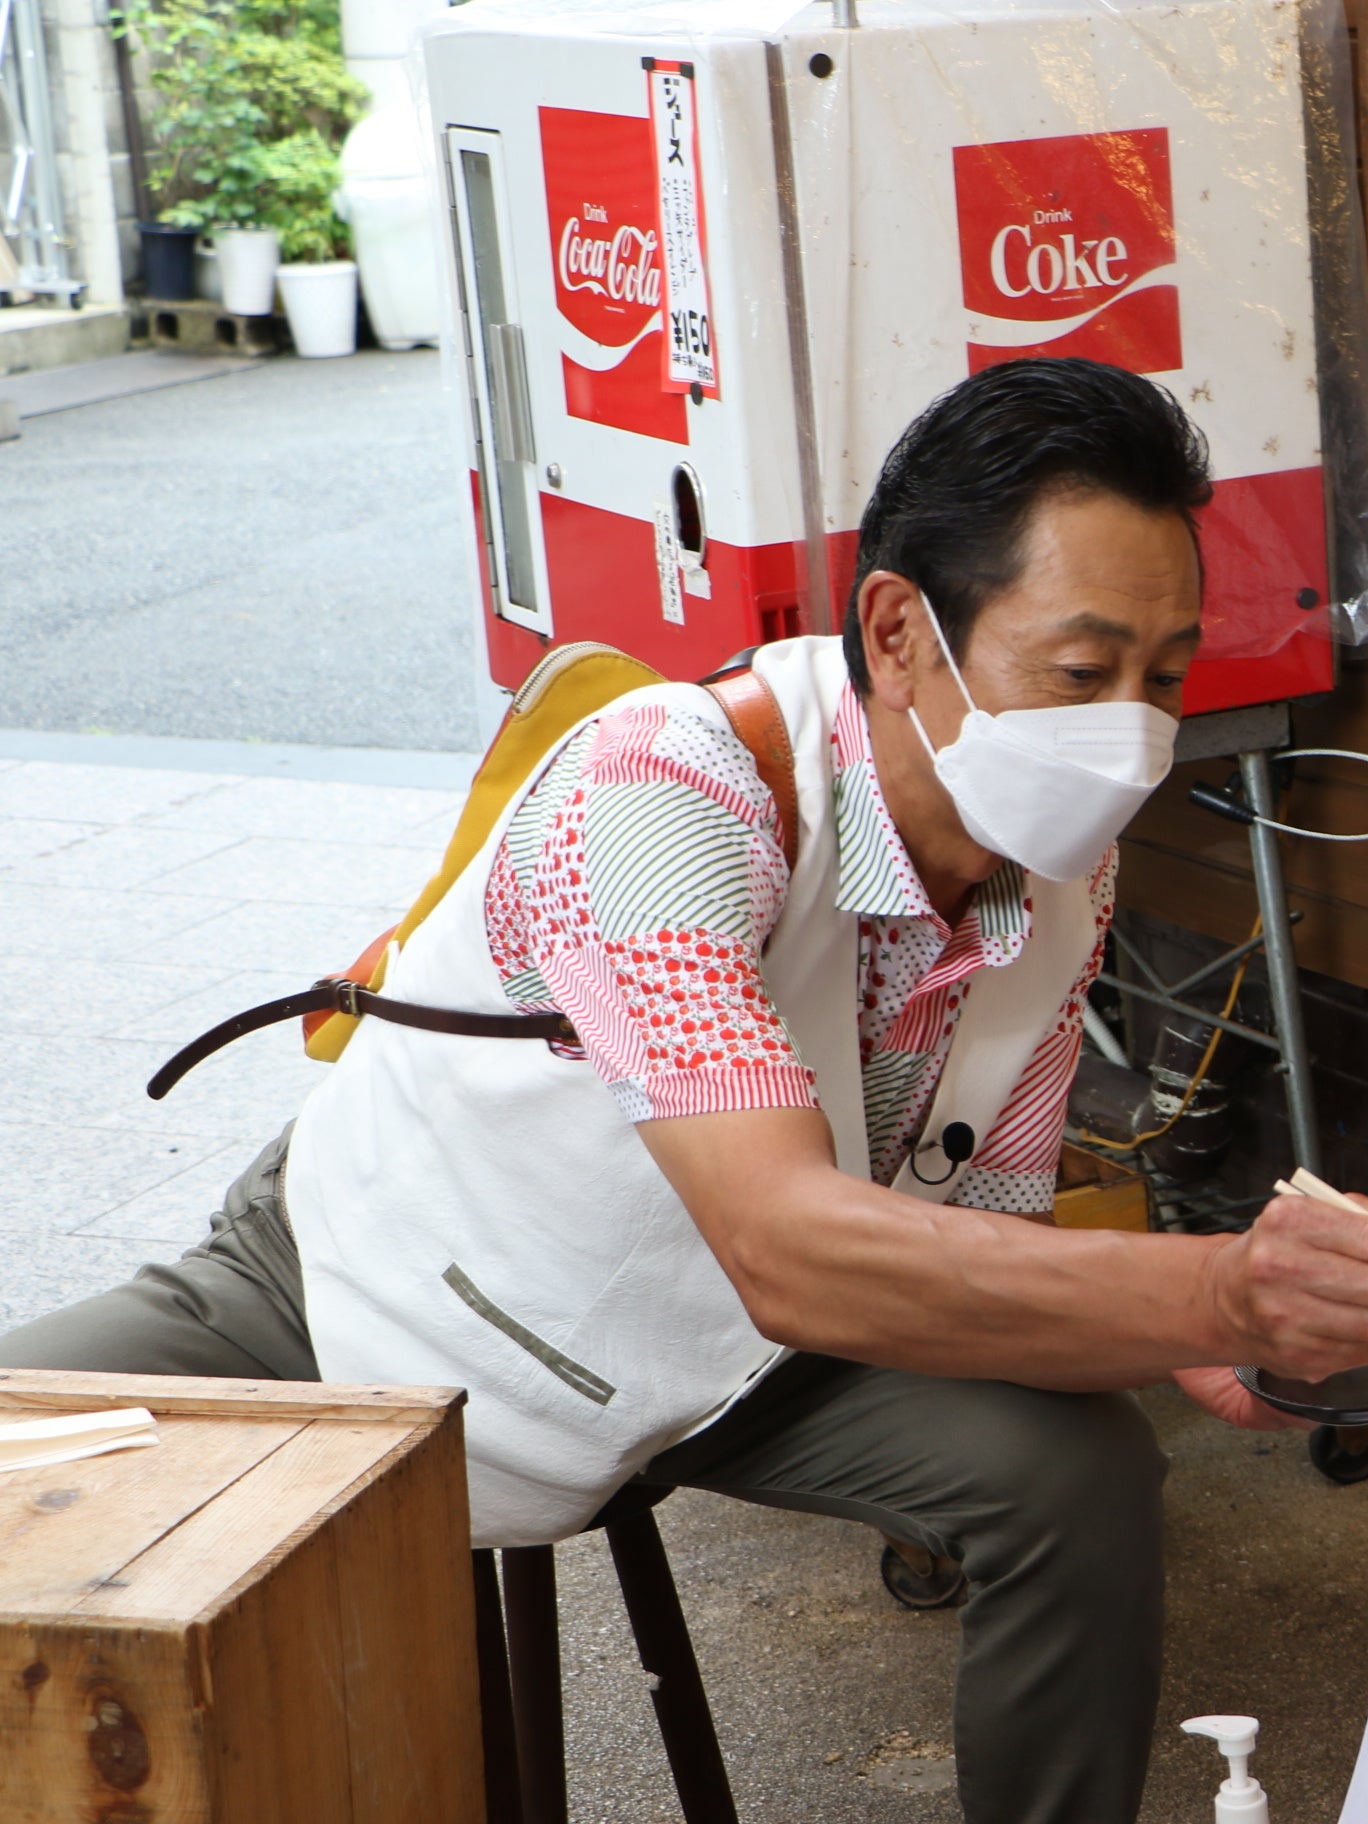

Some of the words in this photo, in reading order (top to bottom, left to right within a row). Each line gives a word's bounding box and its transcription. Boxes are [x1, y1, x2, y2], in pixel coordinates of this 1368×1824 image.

[663, 76, 684, 167] ジュース
[583, 202, 609, 223] Drink
[1034, 209, 1073, 225] Drink
[990, 225, 1129, 298] Coke
[670, 309, 710, 357] ¥150
